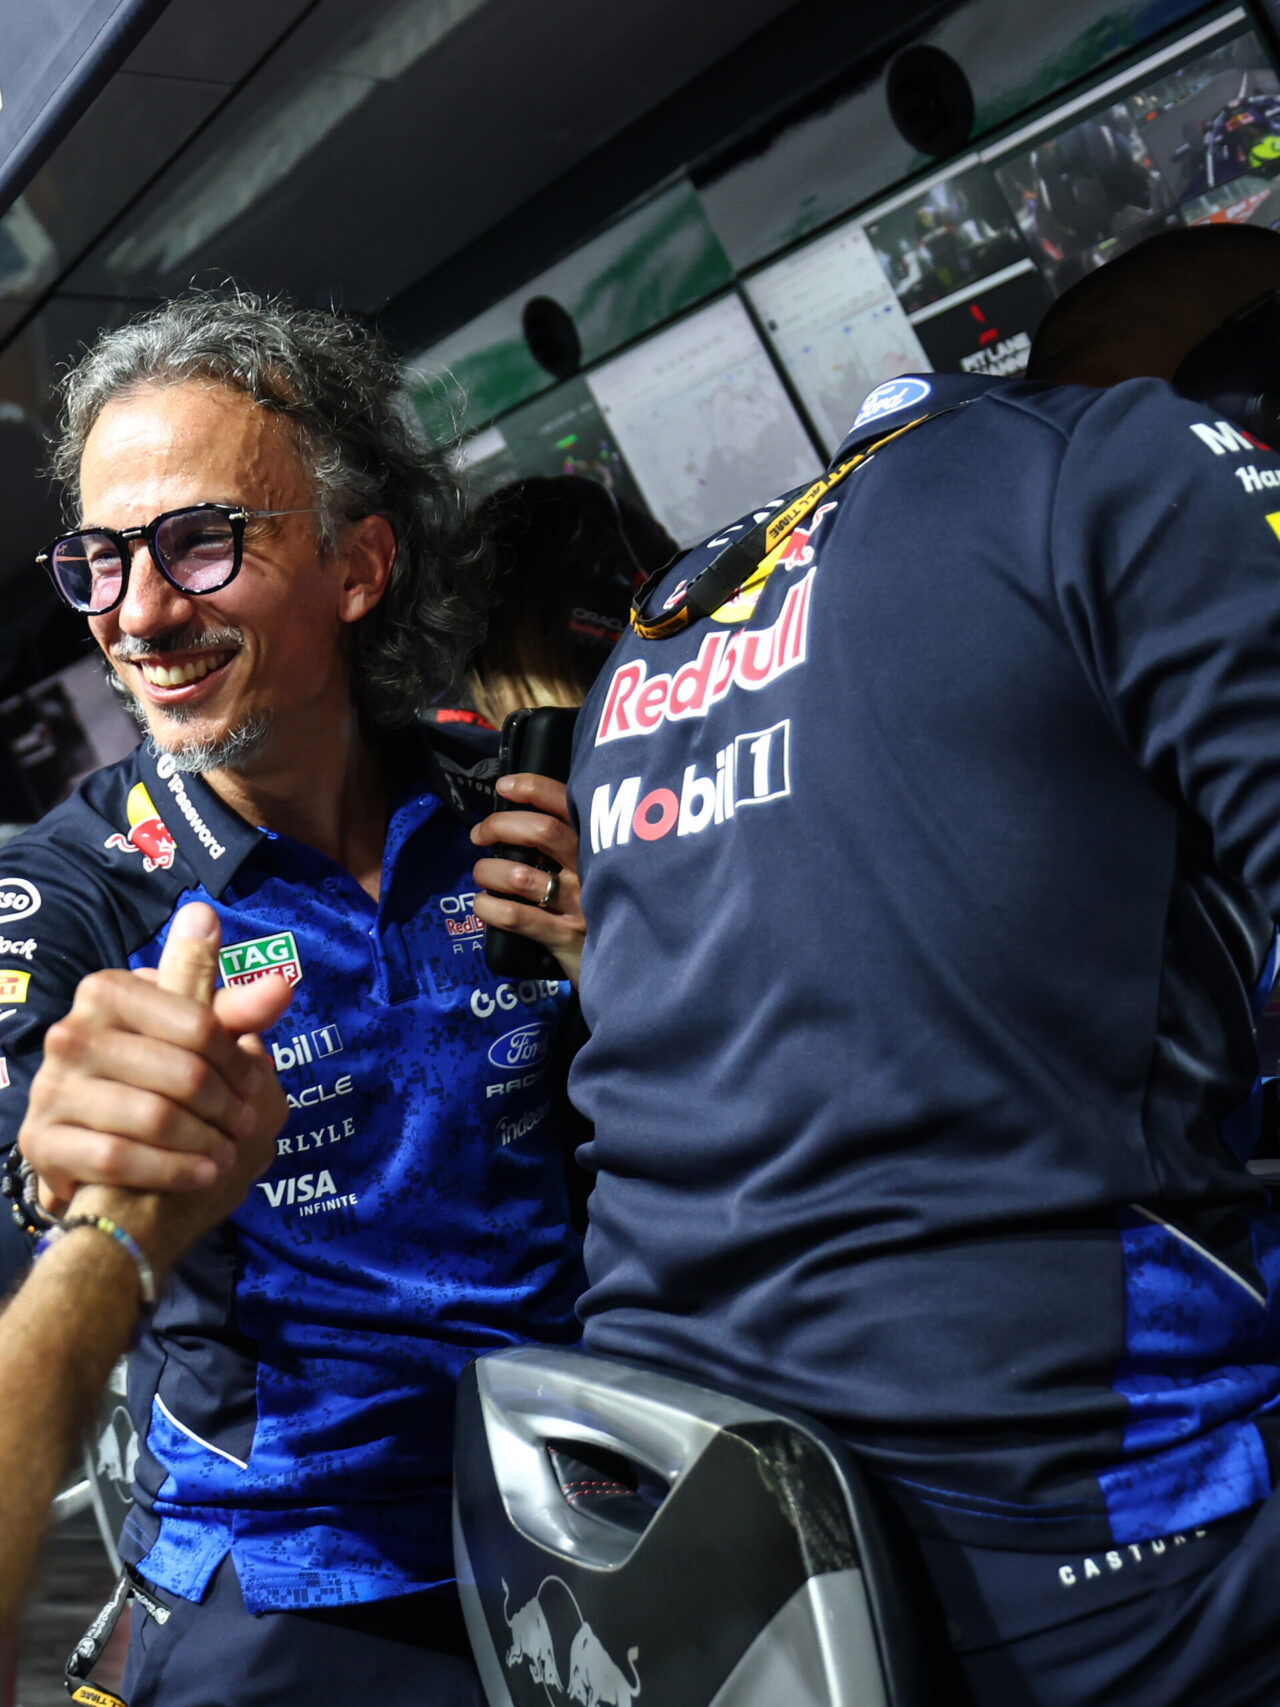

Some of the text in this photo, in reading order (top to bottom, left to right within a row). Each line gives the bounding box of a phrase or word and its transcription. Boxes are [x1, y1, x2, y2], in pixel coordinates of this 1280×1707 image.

[1234, 465, 1280, 493] Ha
[769, 507, 801, 540] TIME
[595, 630, 730, 747] Red
[590, 742, 735, 855] Mobil
[223, 938, 290, 971] TAG
[269, 1033, 313, 1072] bil
[285, 1074, 354, 1109] ACLE
[486, 1073, 537, 1098] RAC
[276, 1117, 356, 1156] RLYLE
[256, 1169, 338, 1208] VISA
[298, 1193, 359, 1217] INFINITE
